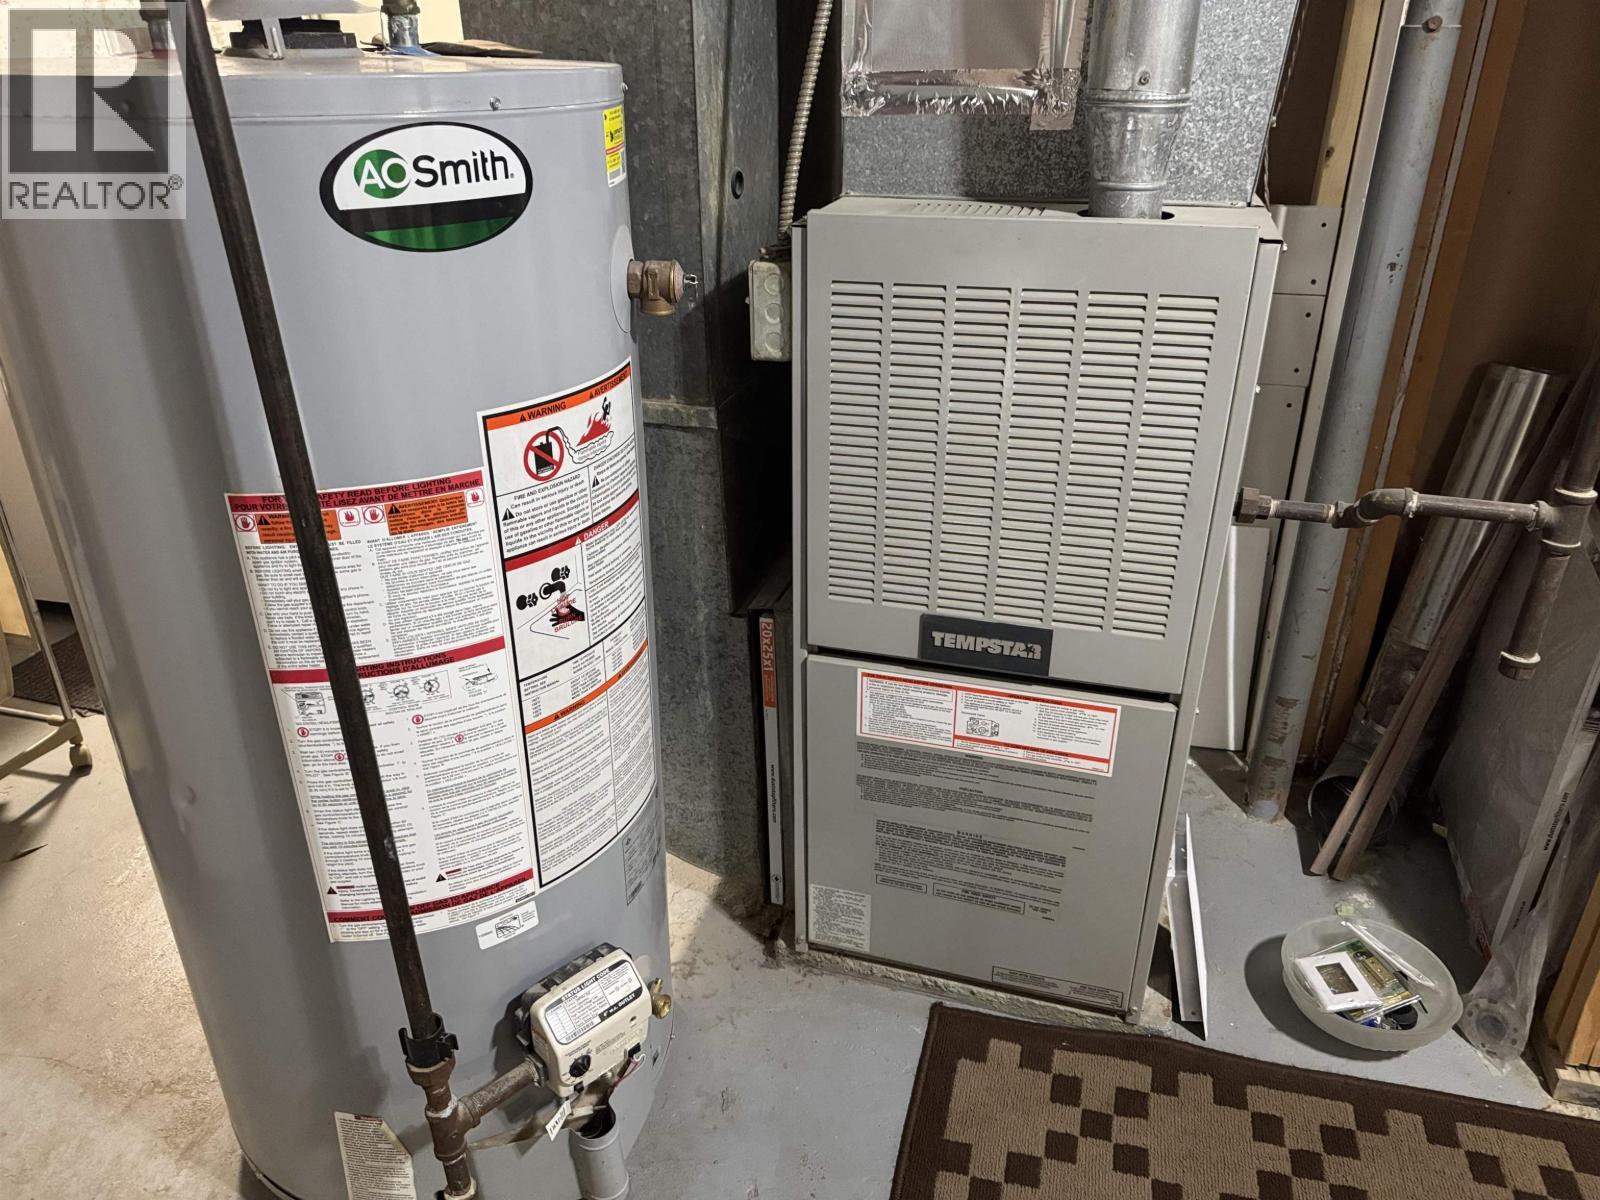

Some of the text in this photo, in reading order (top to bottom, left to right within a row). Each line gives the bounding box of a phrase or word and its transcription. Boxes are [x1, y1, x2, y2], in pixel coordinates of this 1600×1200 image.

[412, 149, 509, 188] Smith
[594, 371, 628, 397] AVERTISSEMENT
[527, 401, 566, 420] WARNING
[262, 477, 451, 504] FOR AFETY READ BEFORE LIGHTING
[333, 497, 357, 507] LISEZ
[358, 493, 385, 505] AVANT
[388, 492, 399, 500] DE
[400, 487, 432, 499] METTRE
[434, 485, 446, 493] EN
[446, 478, 480, 491] MARCHE
[526, 489, 537, 497] AND
[537, 479, 563, 493] EXPLOSION
[583, 521, 609, 540] DANGER
[931, 631, 1042, 660] TEMPSTAR
[386, 652, 447, 667] INSTRUCTIONS
[402, 656, 455, 671] D'ALLUMAGE
[560, 985, 581, 1002] STATUS
[580, 975, 597, 989] LIGHT
[595, 967, 610, 980] CODE
[616, 992, 636, 1007] OUTLET
